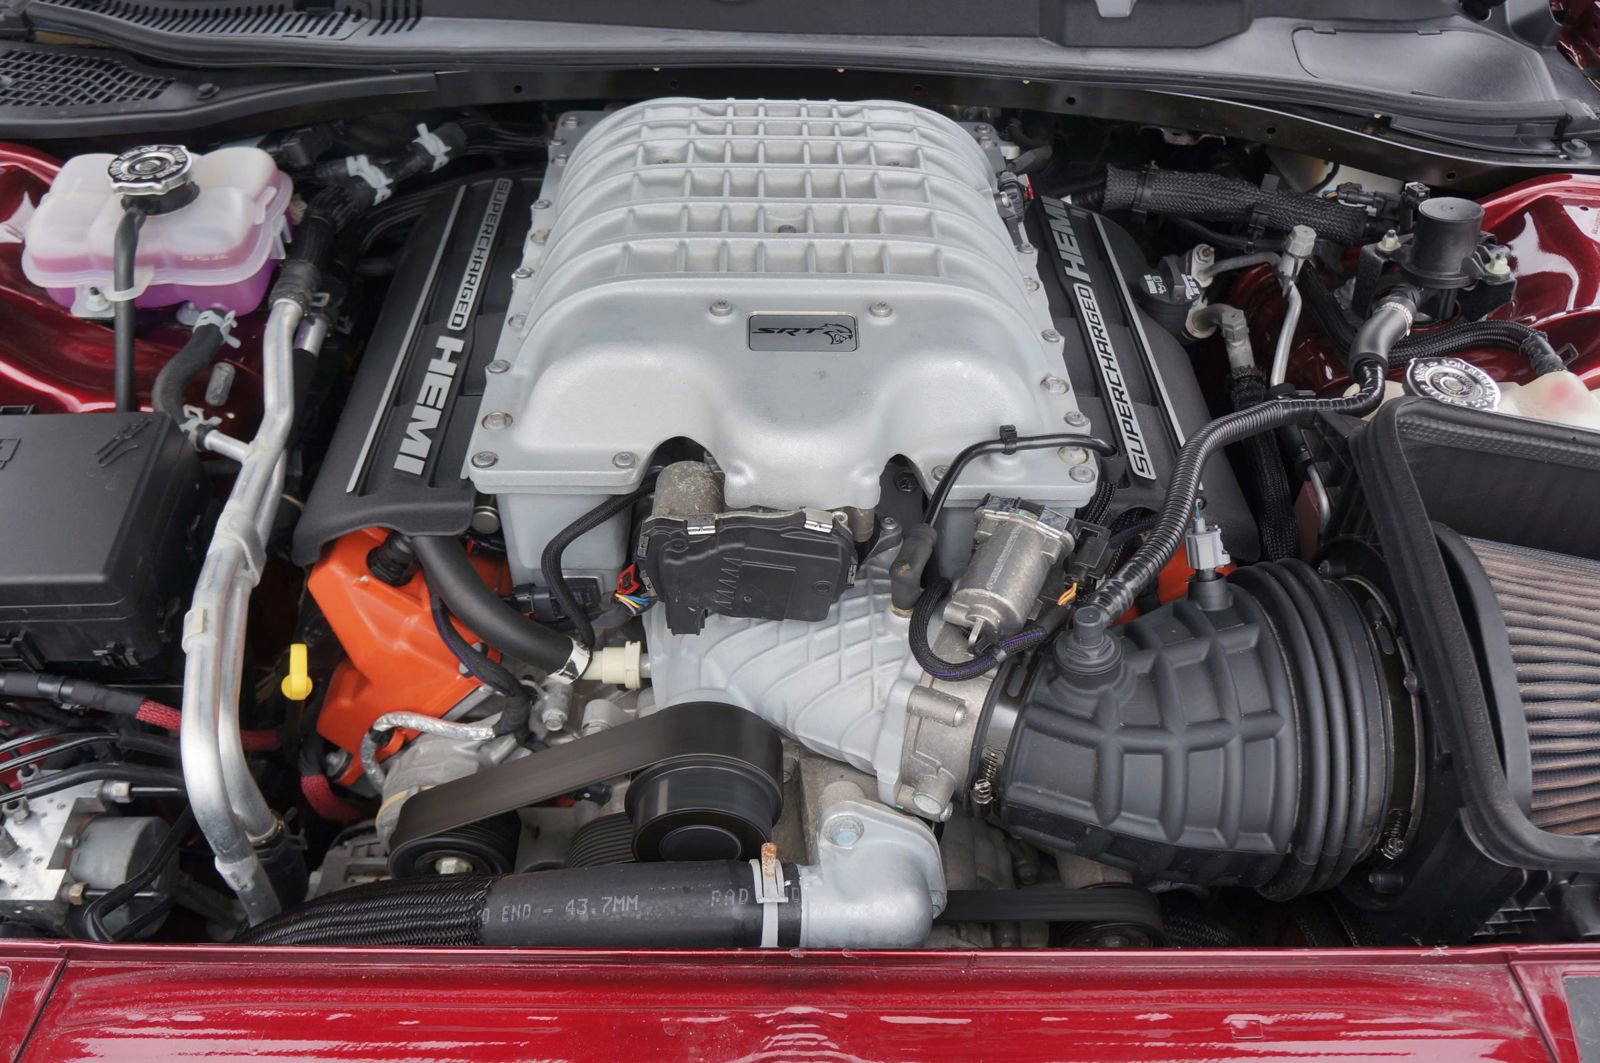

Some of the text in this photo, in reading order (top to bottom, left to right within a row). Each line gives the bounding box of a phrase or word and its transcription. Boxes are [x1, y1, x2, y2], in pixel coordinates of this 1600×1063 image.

[450, 180, 510, 328] SUPERCHARGED
[1041, 196, 1091, 283] HEMI
[752, 327, 824, 336] SRT
[1075, 286, 1152, 477] SUPERCHARGED
[393, 335, 465, 475] HEMI
[501, 903, 531, 922] END
[565, 895, 639, 915] 43.7MM
[711, 887, 749, 906] RAD
